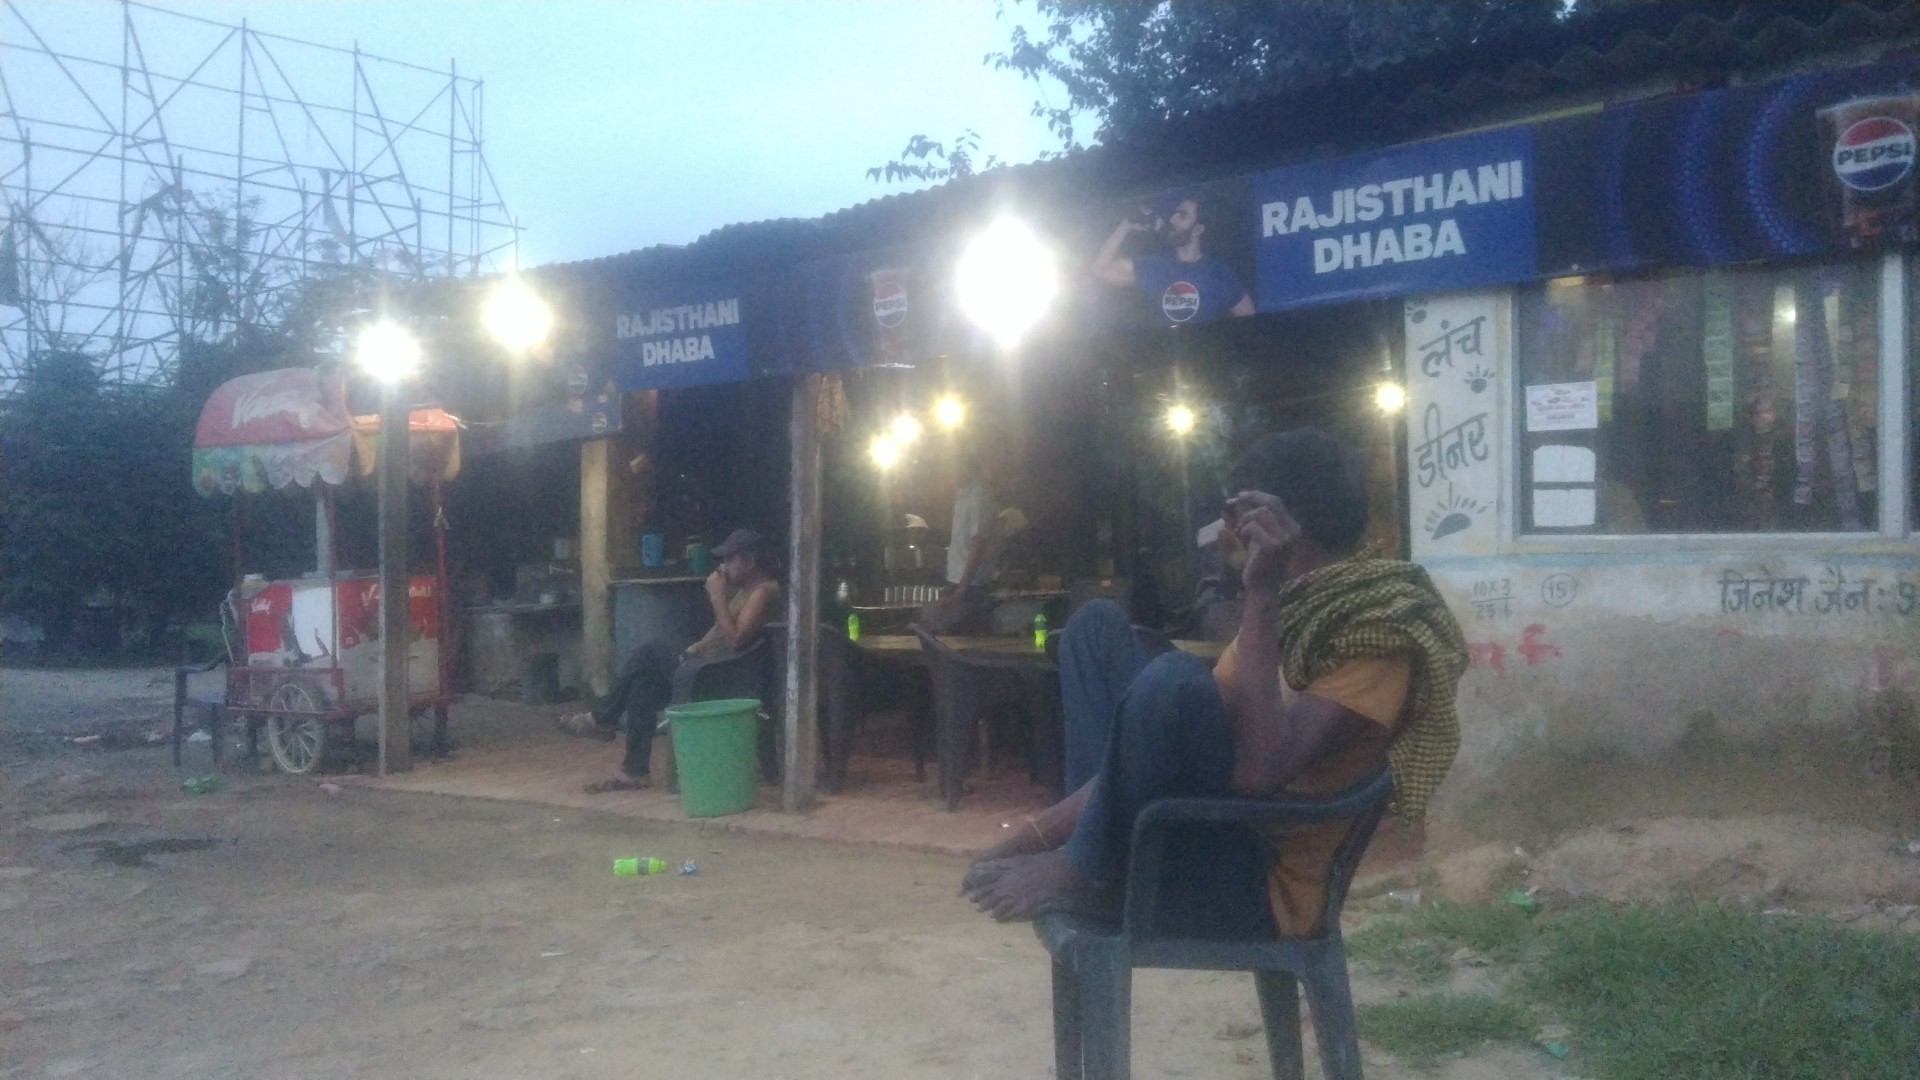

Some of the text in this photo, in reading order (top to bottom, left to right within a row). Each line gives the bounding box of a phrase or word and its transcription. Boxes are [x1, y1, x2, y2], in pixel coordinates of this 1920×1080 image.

[1837, 142, 1912, 166] PEPSI
[1261, 160, 1523, 237] RAJISTHANI
[1313, 219, 1466, 273] DHABA
[616, 298, 740, 339] RAJISTHANI
[1164, 296, 1199, 308] PEPSI
[642, 335, 716, 367] DHABA
[1418, 316, 1487, 378] लंच
[1414, 402, 1489, 488] डीनर
[1717, 565, 1811, 615] जिनेश
